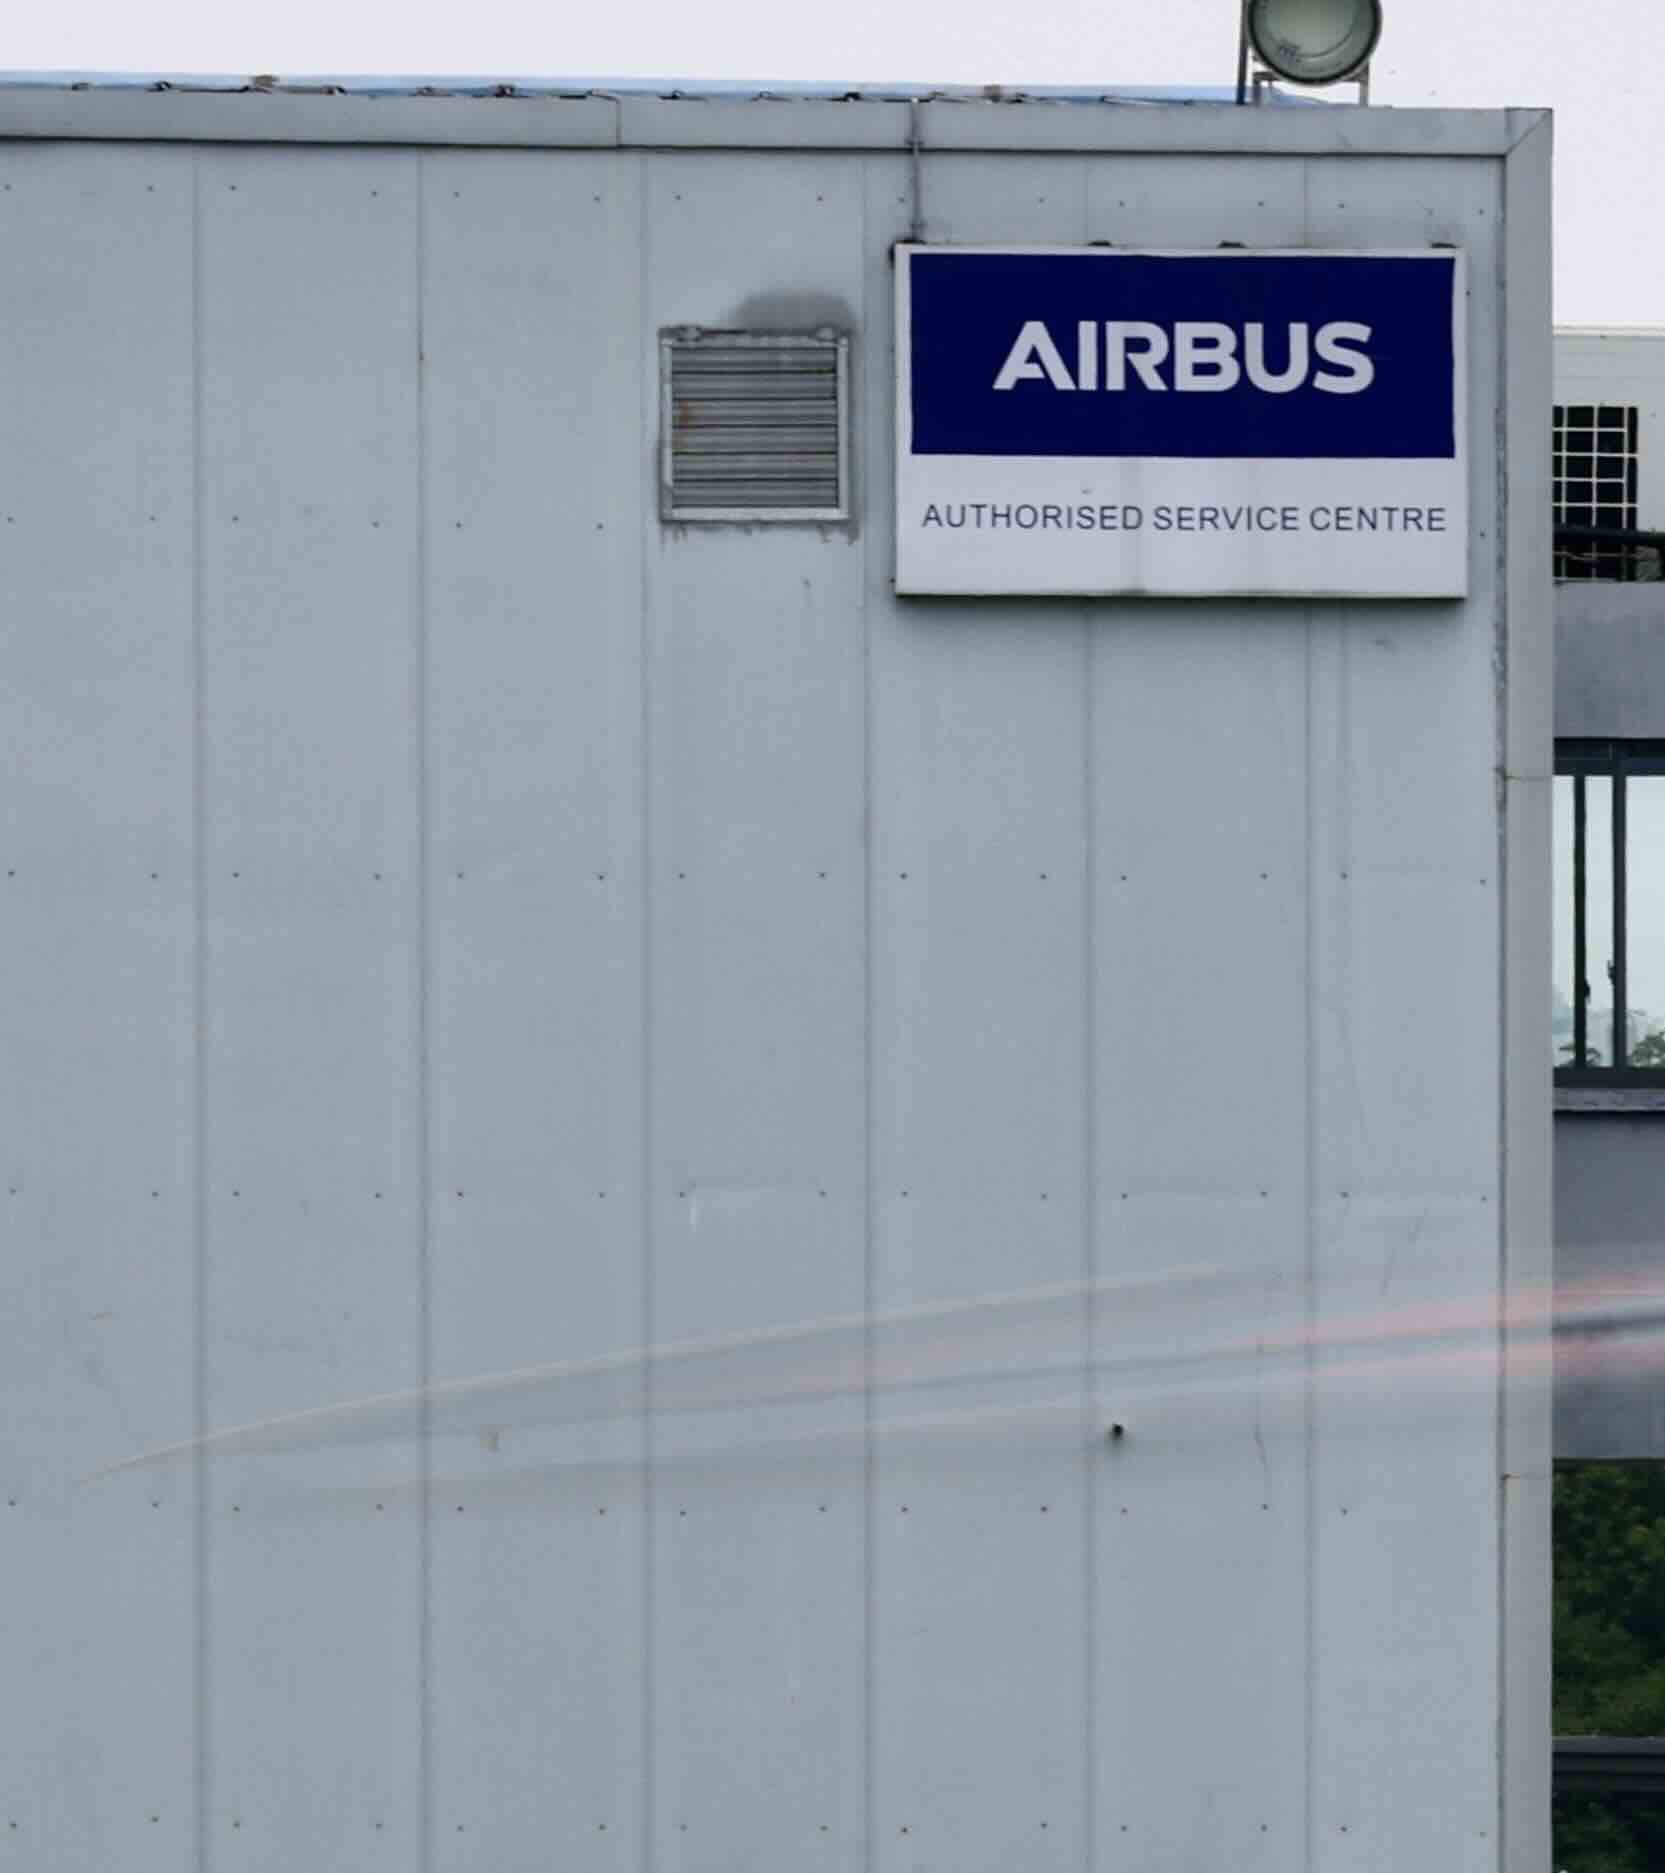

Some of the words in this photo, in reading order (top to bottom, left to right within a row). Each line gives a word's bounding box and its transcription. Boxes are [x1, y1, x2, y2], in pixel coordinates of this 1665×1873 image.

[992, 320, 1375, 394] AIRBUS
[921, 503, 1144, 532] AUTHORISED
[1152, 505, 1300, 532] SERVICE
[1308, 506, 1446, 533] CENTRE
